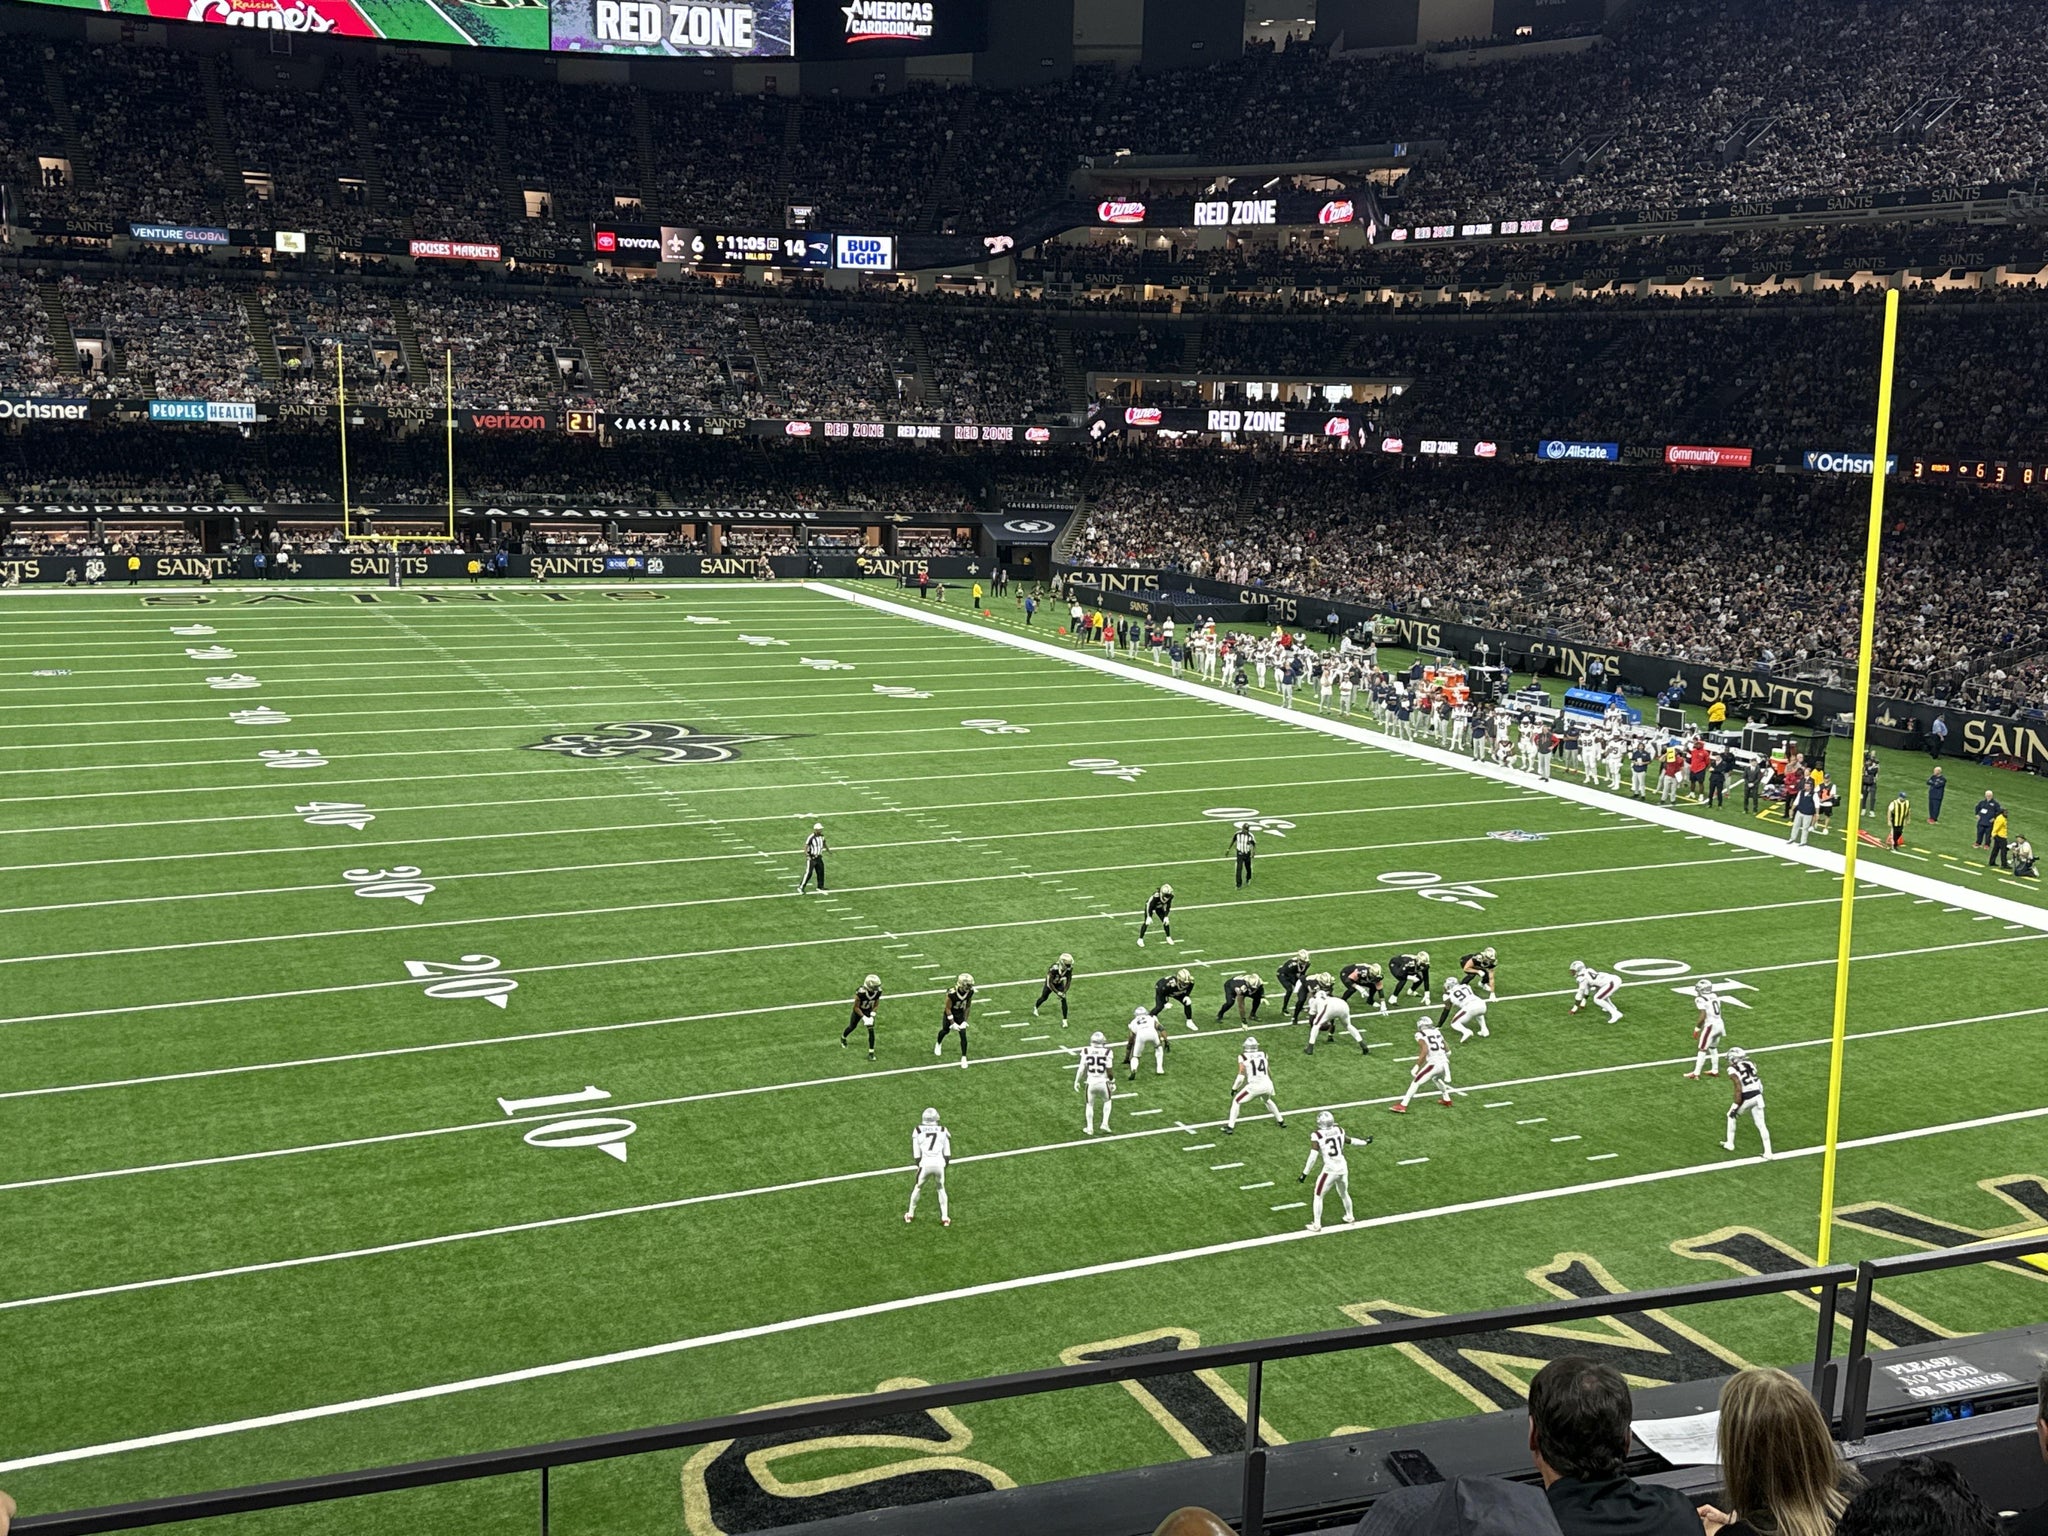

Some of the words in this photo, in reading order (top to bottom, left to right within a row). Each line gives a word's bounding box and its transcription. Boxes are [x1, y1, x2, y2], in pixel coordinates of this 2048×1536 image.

[597, 1, 662, 42] RED
[670, 4, 754, 48] ZONE
[1932, 186, 1981, 203] SAINTS
[1730, 203, 1774, 217] SAINTS
[1827, 195, 1873, 211] SAINTS
[1193, 202, 1228, 226] RED
[1231, 200, 1277, 225] ZONE
[1637, 209, 1678, 223] SAINTS
[66, 221, 114, 232] SAINTS
[132, 227, 183, 240] VENTURE
[185, 231, 228, 242] GLOBAL
[317, 234, 363, 247] SAINTS
[618, 237, 660, 249] TOYOTA
[691, 236, 704, 252] 6
[727, 235, 766, 250] 11:05
[784, 239, 806, 256] 14
[848, 240, 882, 252] BUD
[411, 241, 451, 256] ROUSES
[453, 244, 500, 259] MARKETS
[514, 248, 556, 259] SAINTS
[841, 252, 888, 266] LIGHT
[1752, 260, 1792, 274] SAINTS
[1844, 255, 1886, 270] SAINTS
[1938, 251, 1984, 267] SAINTS
[1504, 271, 1540, 283] SAINTS
[1583, 267, 1620, 279] SAINTS
[1666, 264, 1705, 276] SAINTS
[1085, 274, 1124, 285] SAINTS
[1171, 275, 1210, 286] SAINTS
[1257, 276, 1295, 286] SAINTS
[1342, 276, 1382, 286] SAINTS
[1424, 274, 1462, 284] SAINTS
[0, 400, 88, 419] Ochsner
[152, 403, 205, 419] PEOPLES
[210, 405, 254, 420] HEALTH
[278, 405, 328, 417] SAINTS
[387, 408, 434, 420] SAINTS
[471, 411, 546, 429] verizon
[569, 413, 593, 430] 21
[614, 417, 691, 431] CAESARS
[703, 417, 746, 428] SAINTS
[1208, 410, 1240, 431] RED
[1243, 411, 1285, 432] ZONE
[824, 423, 849, 436] RED
[852, 423, 884, 437] ZONE
[897, 426, 916, 438] RED
[917, 426, 941, 438] ZONE
[954, 426, 978, 439] RED
[982, 427, 1013, 440] ZONE
[1565, 445, 1608, 459] Allstate
[1623, 446, 1663, 459] SAINTS
[1669, 446, 1720, 465] Community
[1817, 453, 1894, 474] Ochsnr
[44, 504, 266, 514] SUPERDOME
[636, 510, 820, 520] SUPERDOME
[530, 557, 604, 575] SAINTS
[700, 558, 764, 575] SAINT
[140, 591, 671, 607] SAINTS
[1130, 601, 1149, 614] SAINTS
[960, 718, 1031, 735] 50
[258, 749, 329, 768] 50
[1067, 758, 1147, 776] 40
[295, 802, 376, 825] 40
[342, 866, 436, 899] 30
[1376, 871, 1498, 902] 20
[403, 954, 519, 998] 20
[1453, 987, 1472, 1001] 97
[1712, 1000, 1720, 1016] 0
[1427, 1035, 1446, 1051] 53
[1086, 1056, 1107, 1074] 25
[1250, 1059, 1266, 1076] 14
[497, 1085, 637, 1148] 10
[926, 1132, 937, 1151] 7
[1325, 1136, 1343, 1157] 31
[1886, 1356, 1958, 1375] PLEASE
[1898, 1373, 1928, 1386] NO
[1932, 1366, 1979, 1381] FOOD
[1908, 1386, 1940, 1398] OR
[1941, 1373, 2008, 1395] DRINKS
